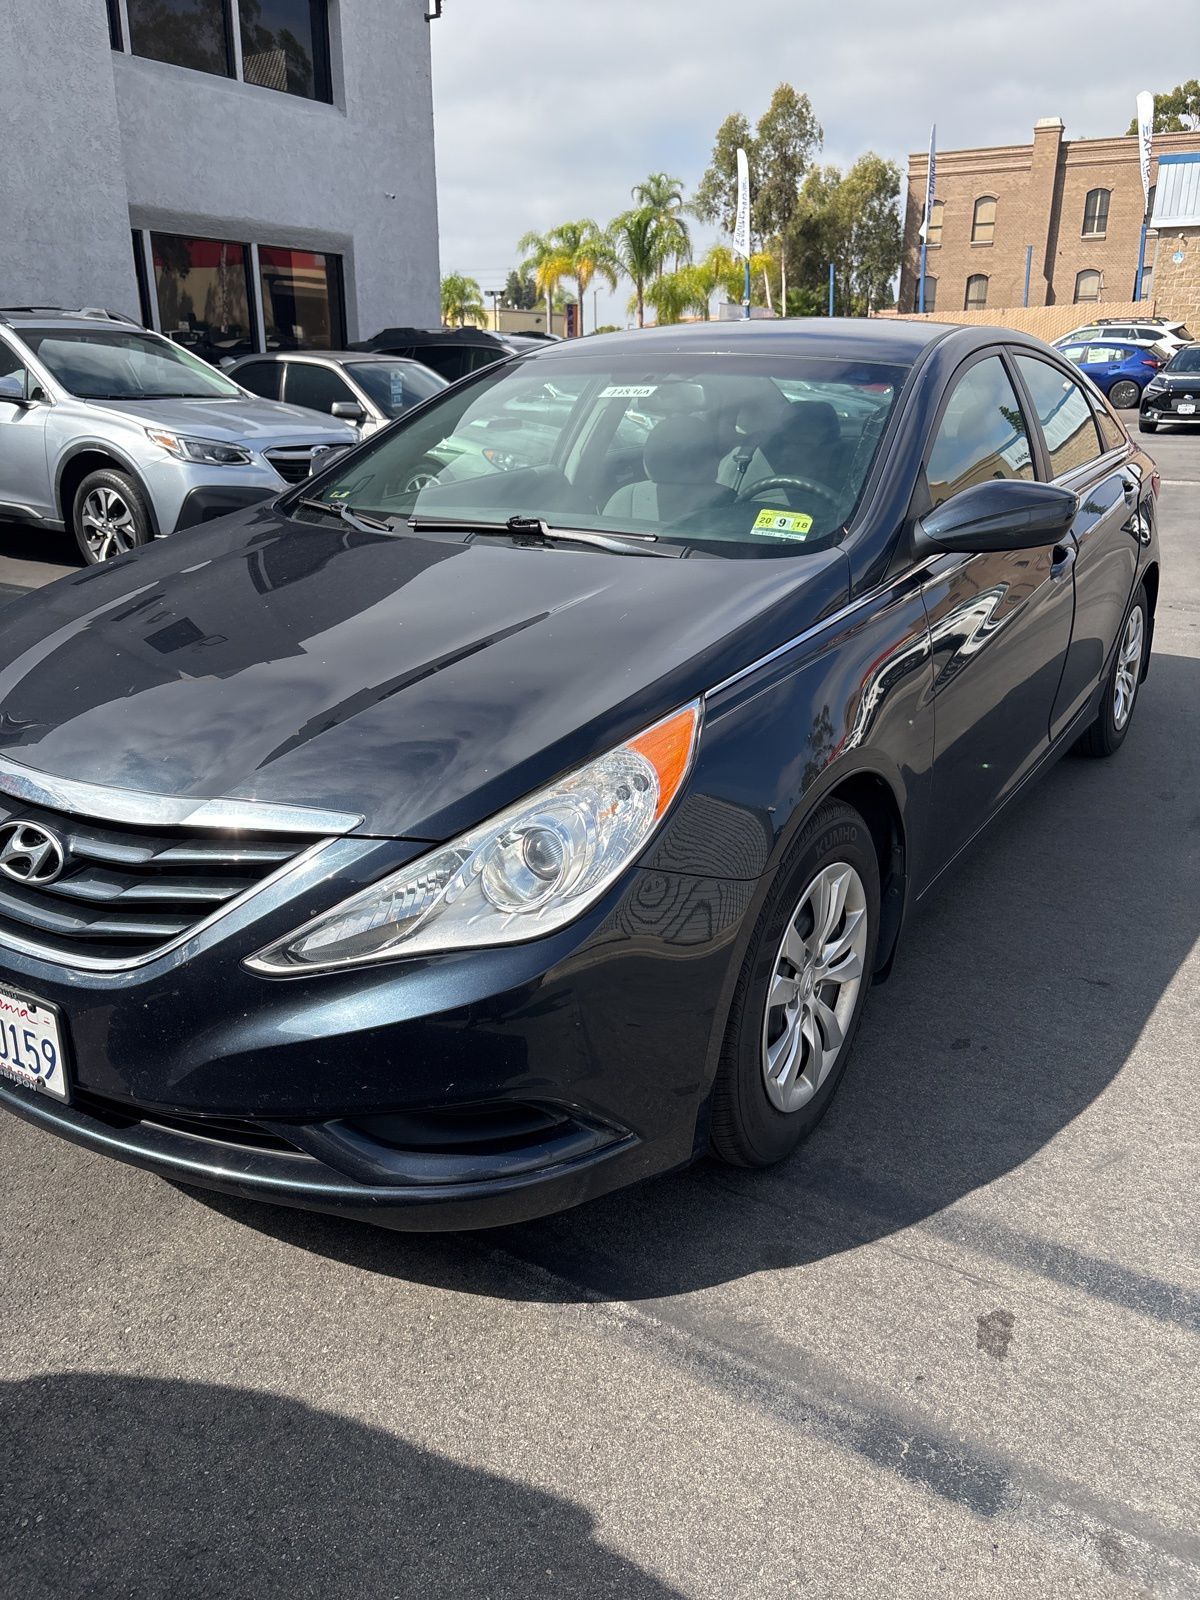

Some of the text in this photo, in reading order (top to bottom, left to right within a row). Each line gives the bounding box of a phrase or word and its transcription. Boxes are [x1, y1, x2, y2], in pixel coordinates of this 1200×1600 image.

[759, 517, 809, 529] 20 9 18
[815, 826, 857, 860] KUMHO
[0, 999, 38, 1025] nia
[0, 1068, 37, 1092] ENSON
